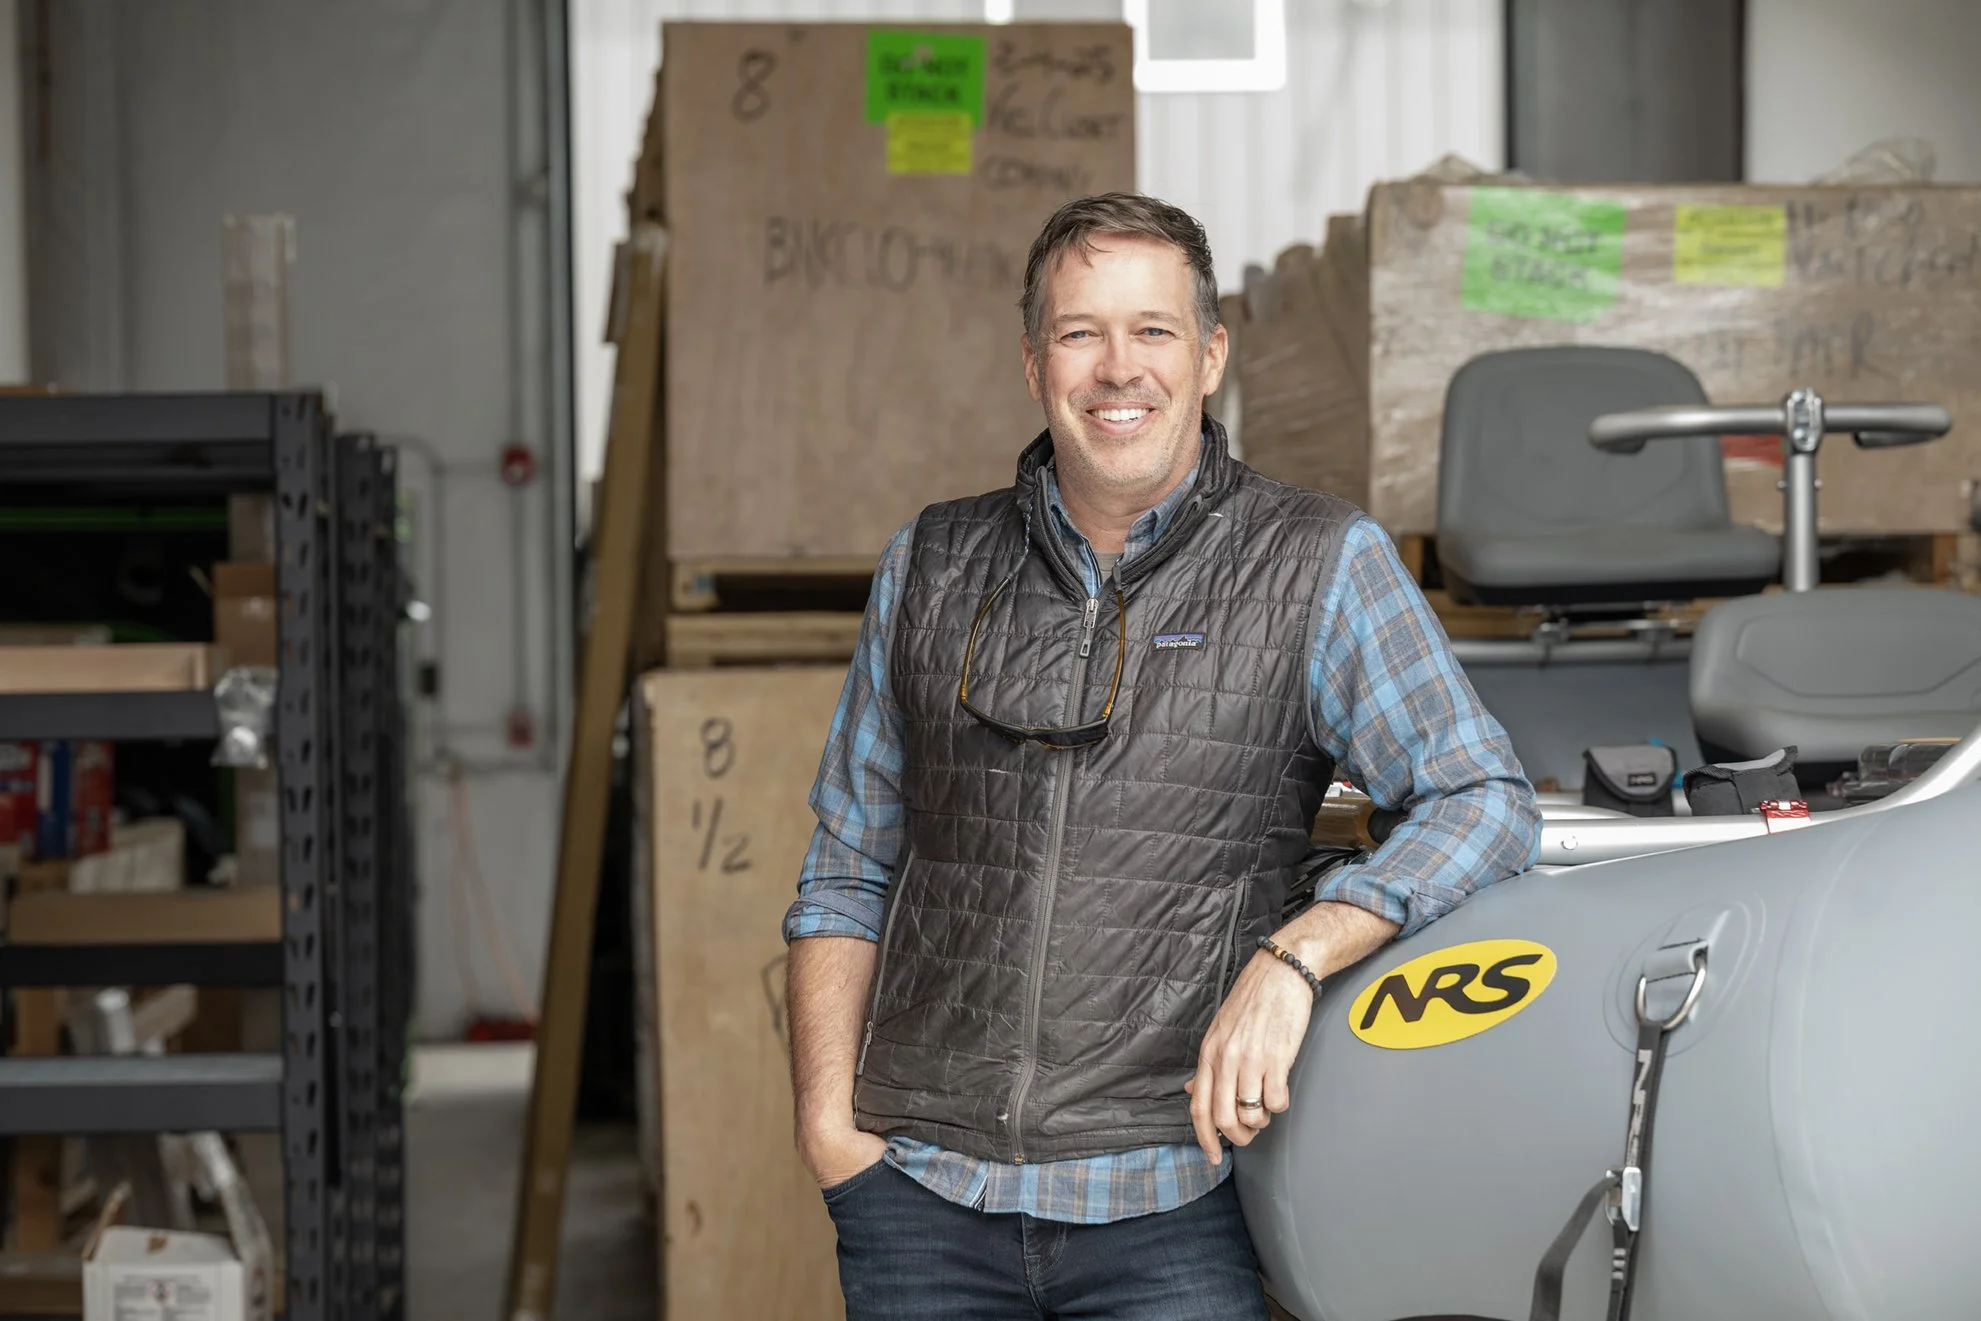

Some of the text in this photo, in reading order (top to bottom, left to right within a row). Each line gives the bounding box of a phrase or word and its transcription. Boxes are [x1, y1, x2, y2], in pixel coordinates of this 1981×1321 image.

[732, 49, 778, 123] 8
[1156, 640, 1197, 648] patagonia
[701, 716, 735, 778] 8
[1360, 954, 1543, 1030] NRS
